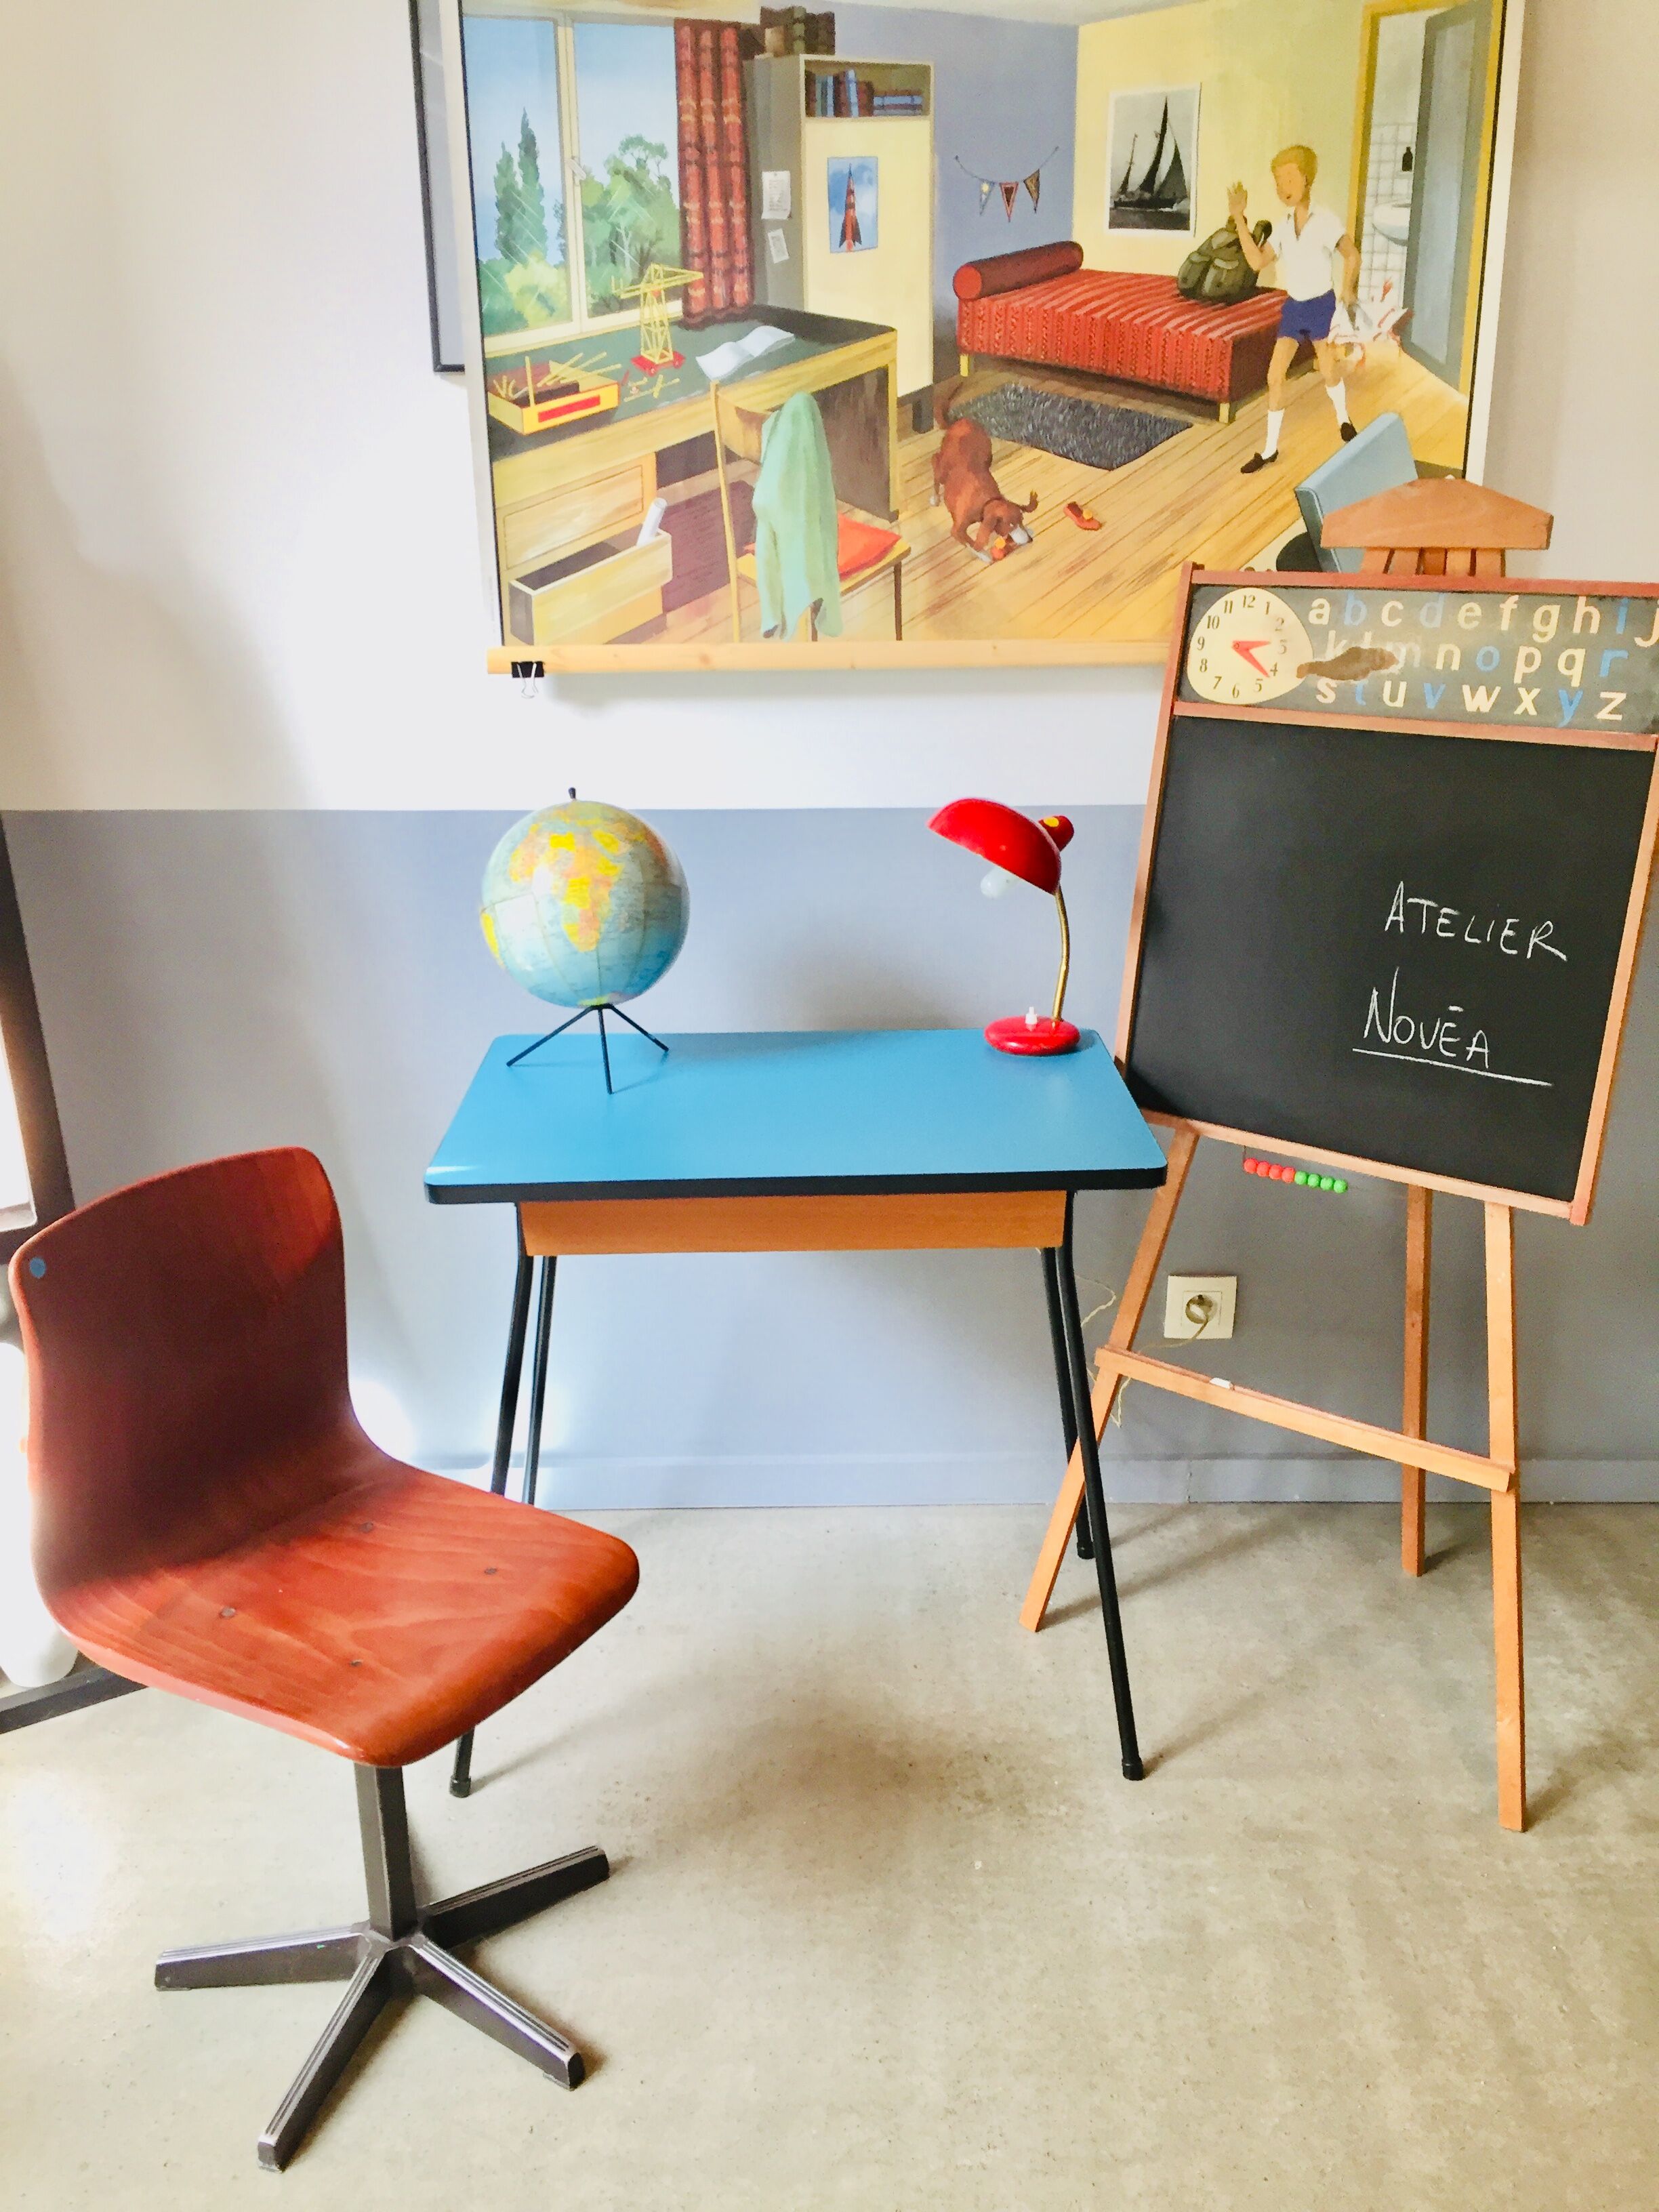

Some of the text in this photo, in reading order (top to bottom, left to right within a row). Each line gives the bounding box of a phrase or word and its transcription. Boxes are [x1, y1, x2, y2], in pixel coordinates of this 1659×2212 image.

[1224, 600, 1233, 615] 11
[1242, 595, 1256, 609] 12
[1265, 601, 1271, 615] 1
[1207, 615, 1221, 630] 10
[1275, 617, 1285, 632] 2
[1309, 598, 1331, 626] a
[1344, 591, 1368, 626] b
[1380, 600, 1404, 628] c
[1419, 592, 1447, 629] d
[1457, 602, 1483, 630] e
[1499, 594, 1519, 632] f
[1532, 605, 1561, 643] g
[1572, 596, 1601, 634] h
[1197, 636, 1206, 651] 9
[1200, 658, 1208, 674] 8
[1269, 661, 1279, 678] 4
[1435, 643, 1462, 671] n
[1475, 645, 1501, 673] o
[1513, 645, 1542, 685] p
[1557, 648, 1586, 688] q
[1599, 649, 1629, 678] r
[1212, 676, 1223, 691] 7
[1254, 678, 1264, 693] 5
[1232, 684, 1240, 699] 6
[1316, 678, 1338, 704] s
[1382, 680, 1408, 708] u
[1423, 682, 1447, 710] v
[1462, 684, 1502, 713] w
[1513, 687, 1542, 716] x
[1557, 689, 1584, 729] y
[1595, 691, 1627, 721] z
[1384, 880, 1568, 962] ATELIER
